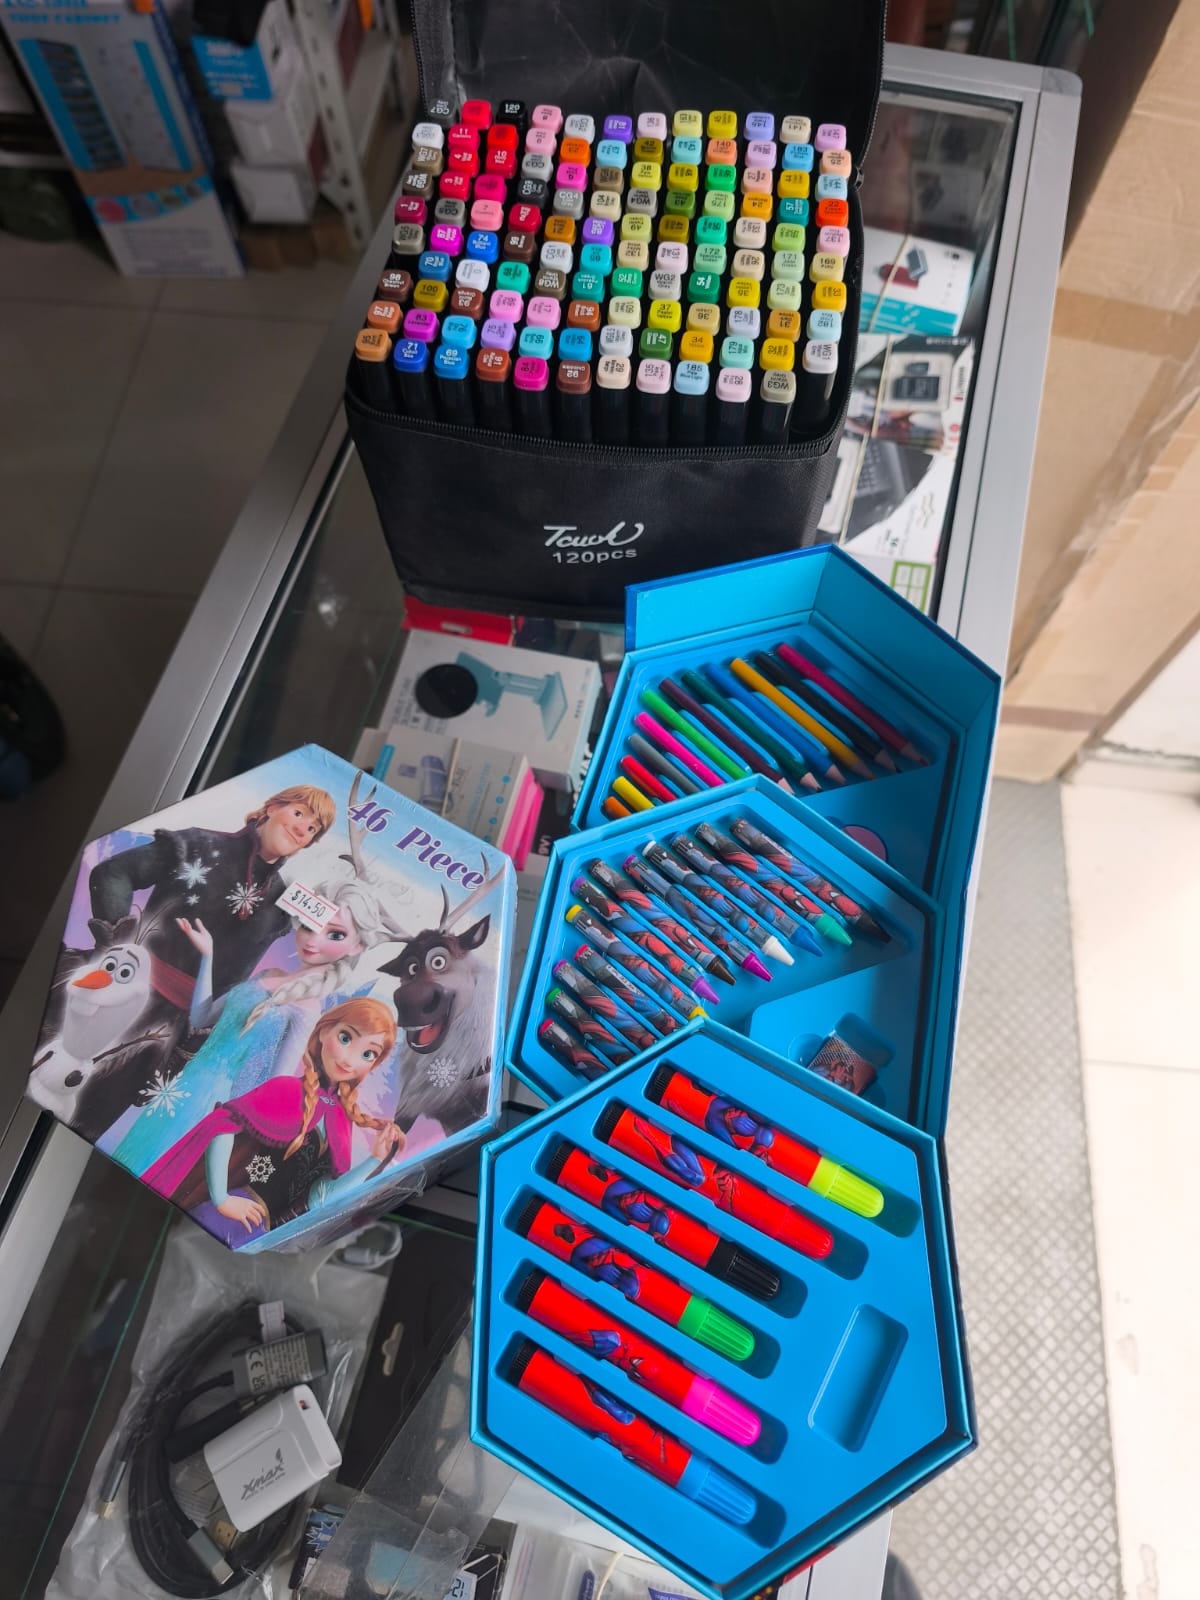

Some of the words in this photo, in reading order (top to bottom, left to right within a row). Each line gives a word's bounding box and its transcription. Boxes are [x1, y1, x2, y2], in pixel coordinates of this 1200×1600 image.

[421, 284, 439, 293] 100
[767, 380, 790, 391] WG3
[552, 549, 638, 564] 120pcs
[347, 800, 395, 834] 46
[393, 825, 486, 892] Piece
[290, 889, 327, 918] $14.50
